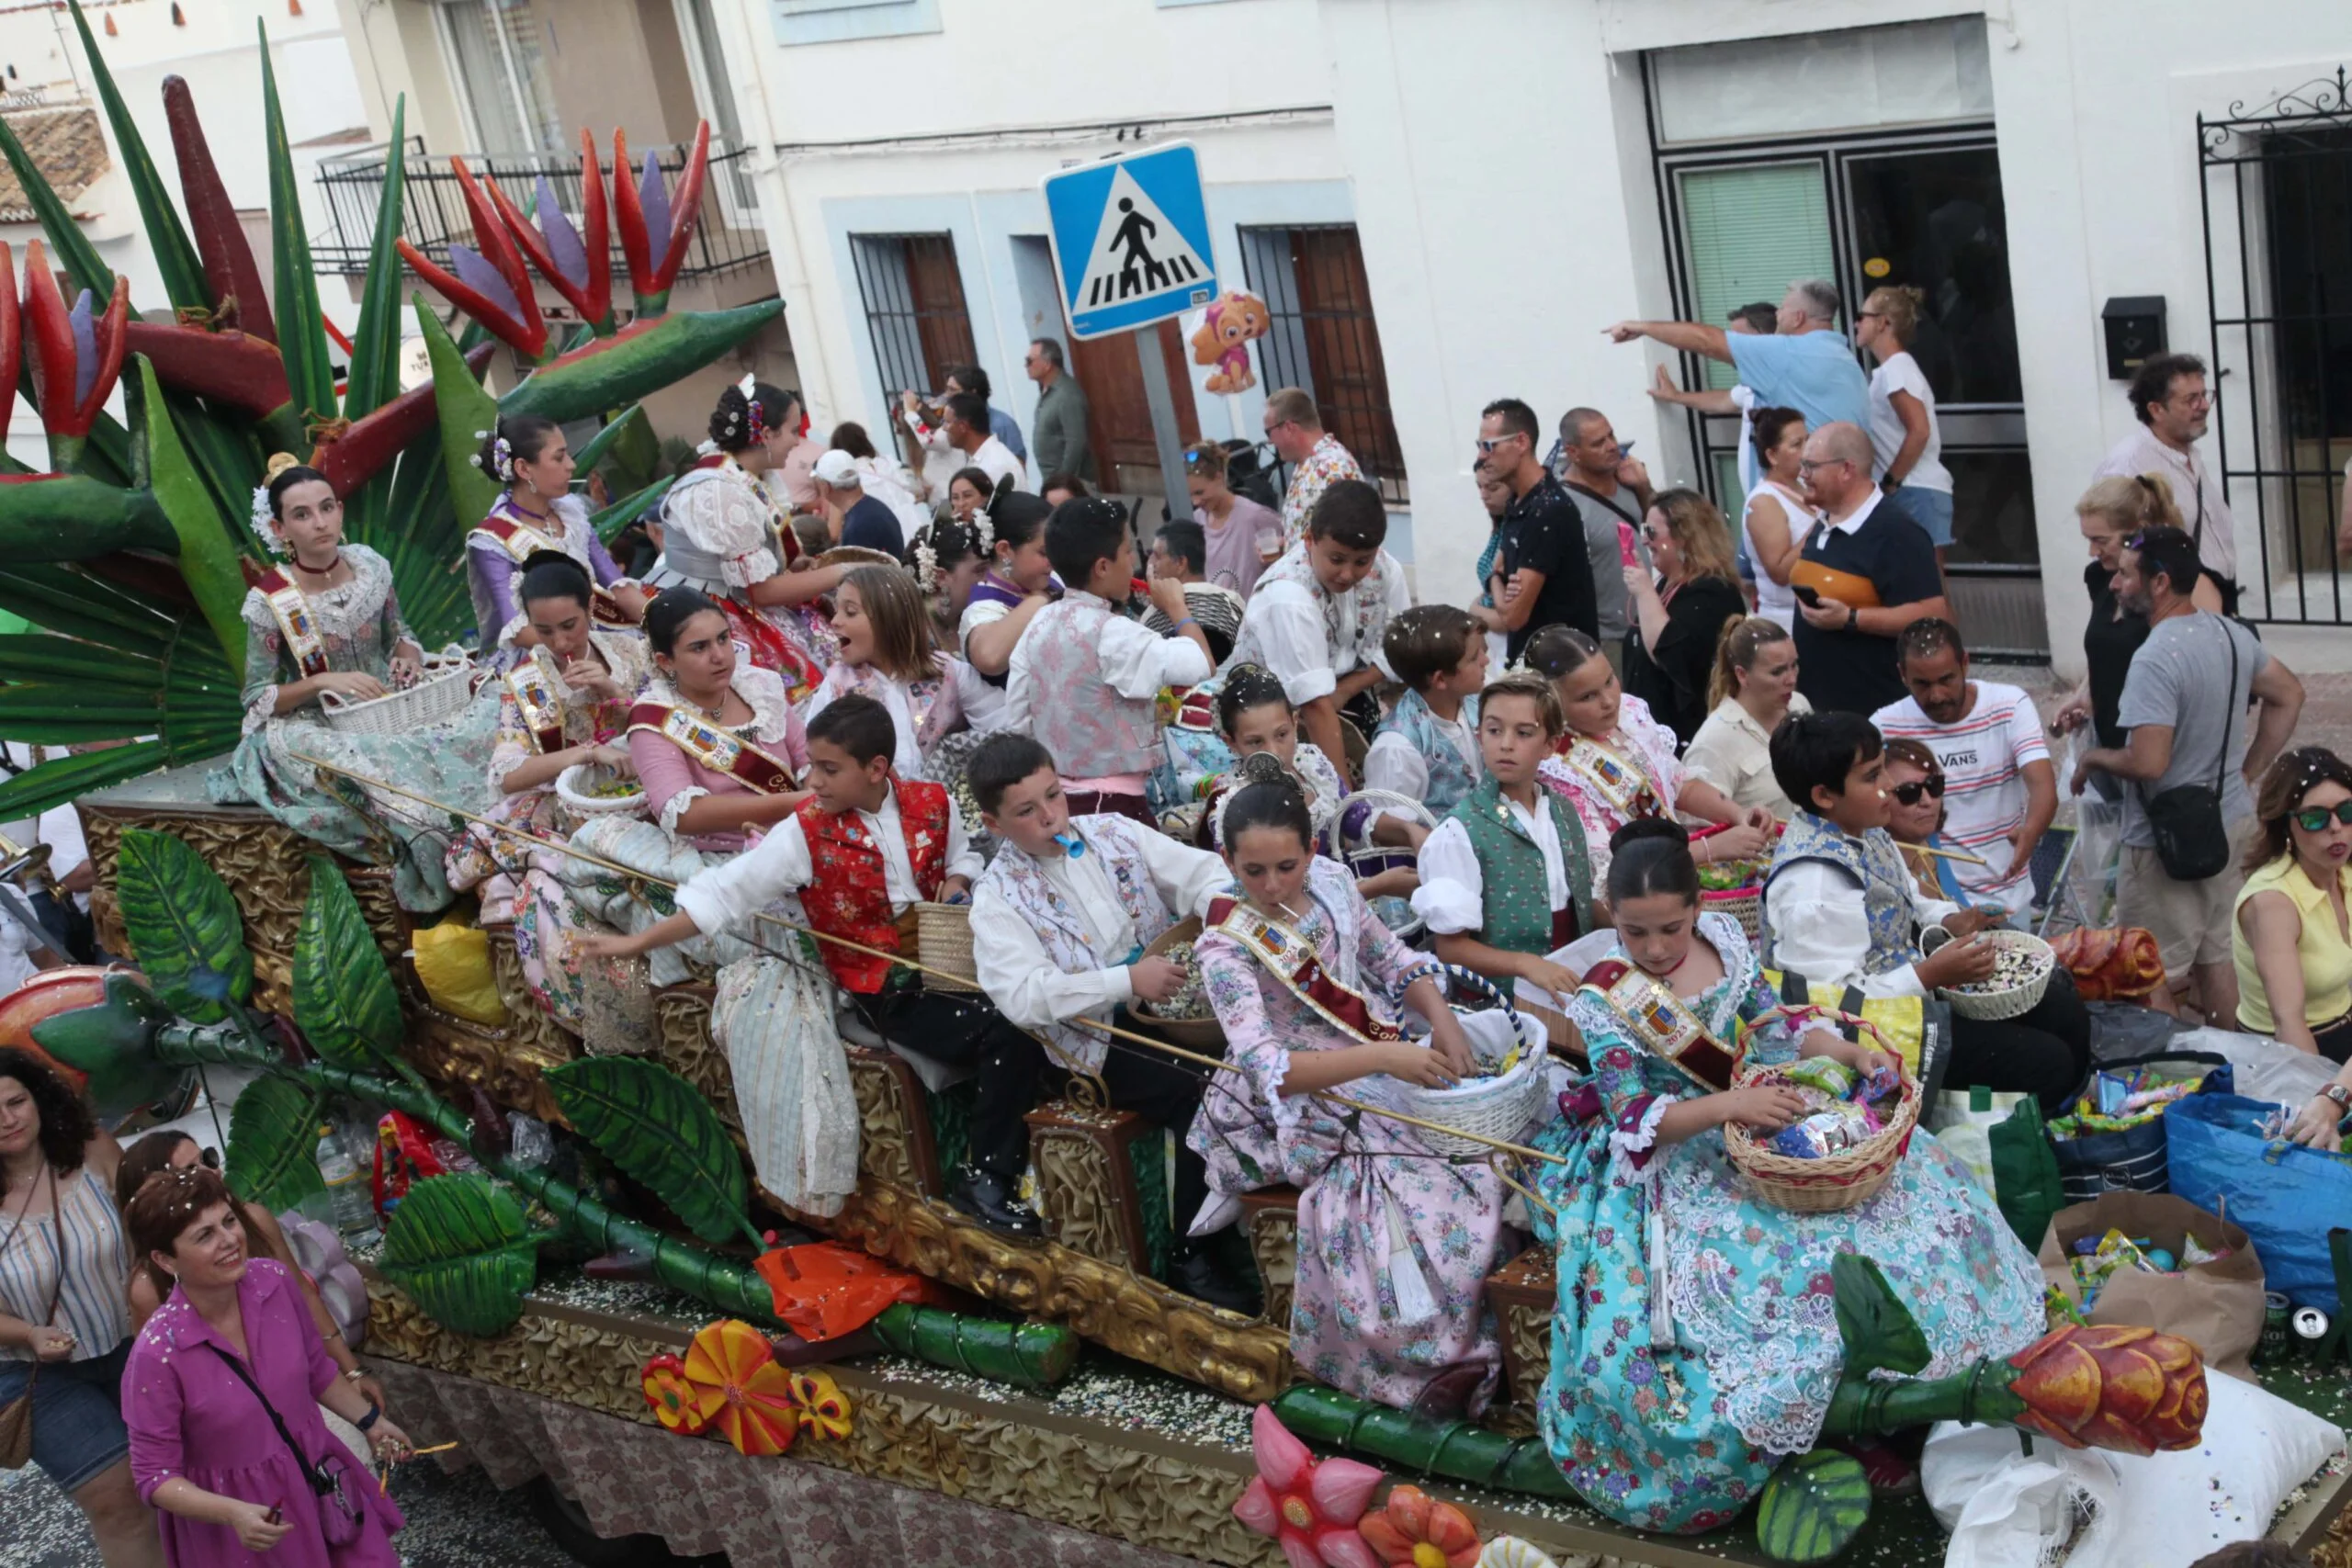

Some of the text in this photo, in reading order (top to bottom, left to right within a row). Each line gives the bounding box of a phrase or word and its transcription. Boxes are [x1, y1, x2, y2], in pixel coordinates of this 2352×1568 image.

[712, 740, 728, 760] 2023
[1938, 750, 1977, 767] VANS
[1278, 945, 1297, 964] 2023
[1665, 1024, 1689, 1046] 2023
[1923, 1022, 1936, 1072] masymas
